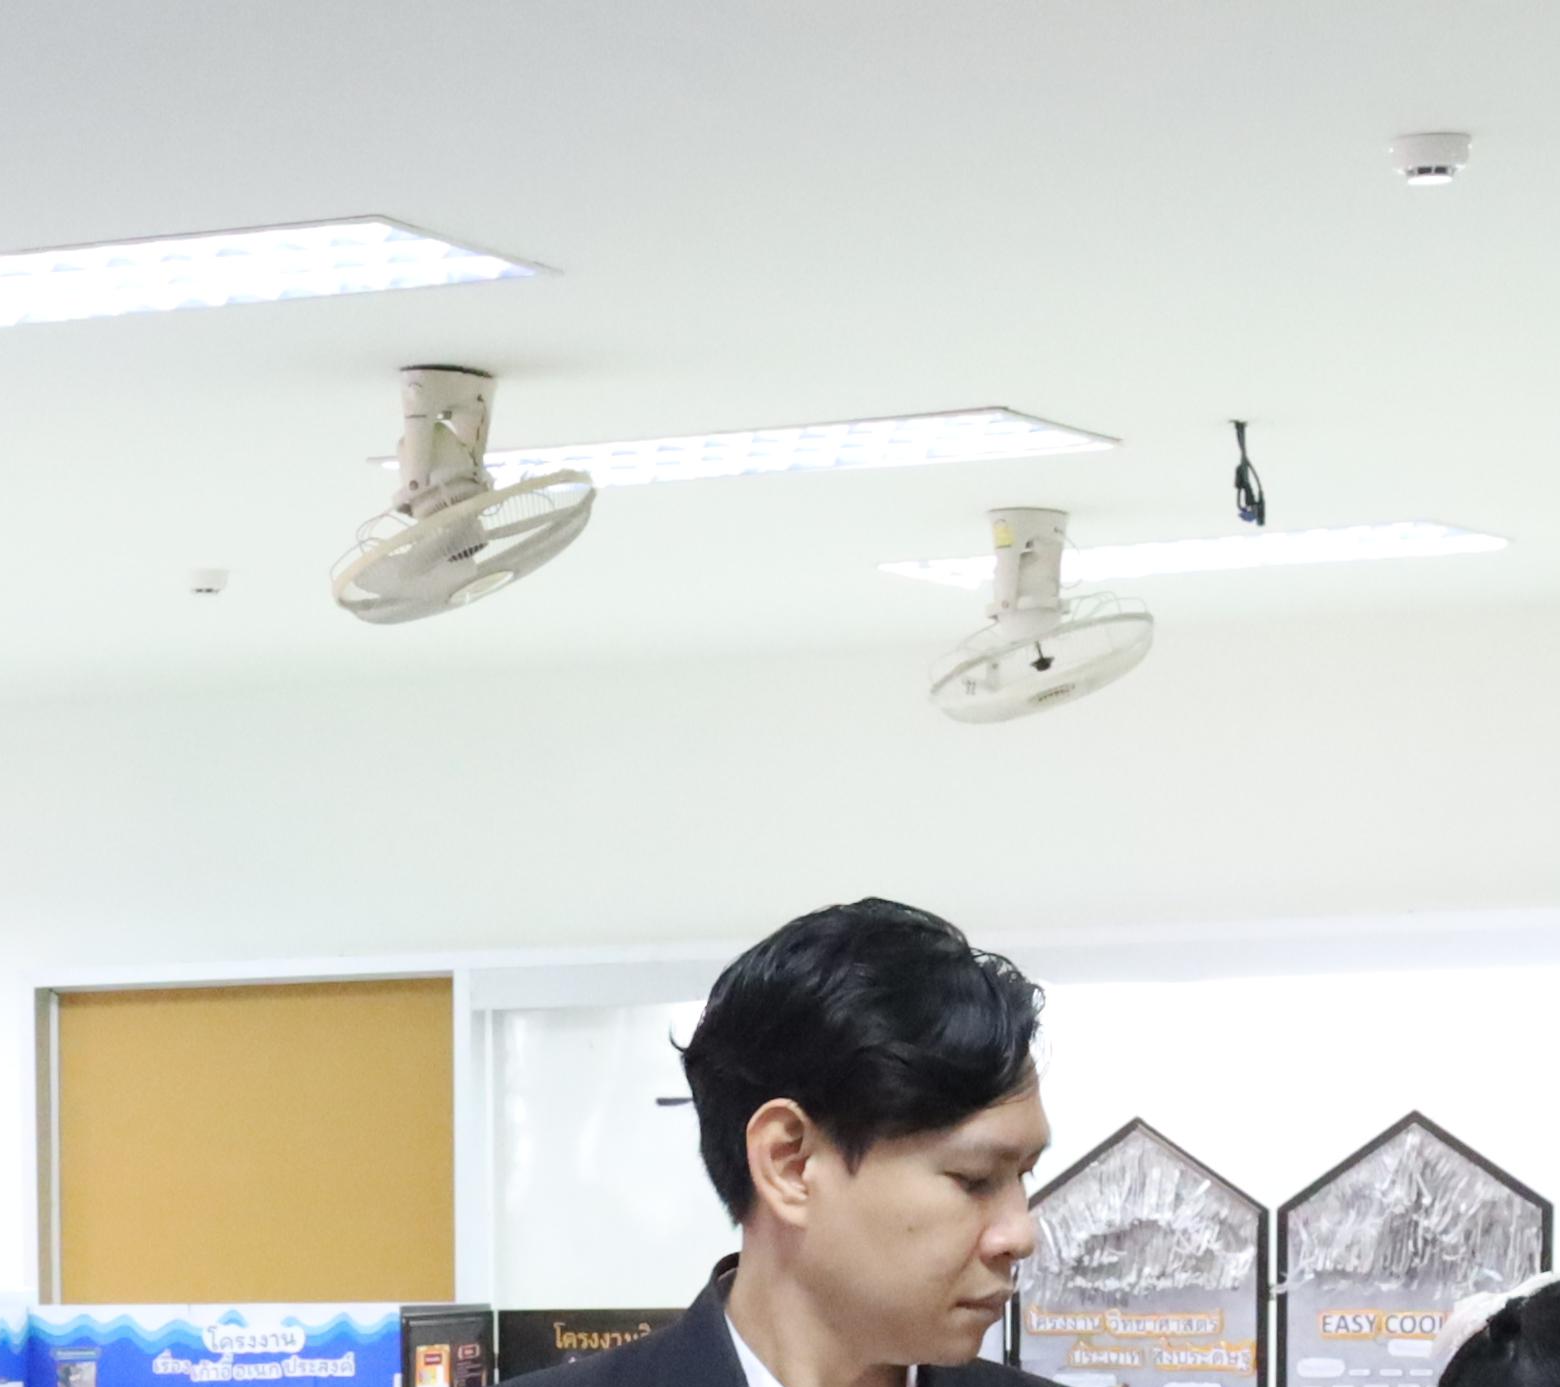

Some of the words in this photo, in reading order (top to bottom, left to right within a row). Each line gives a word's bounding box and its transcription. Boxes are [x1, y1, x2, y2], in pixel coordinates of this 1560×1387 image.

[1321, 1314, 1377, 1334] EASY
[205, 1324, 297, 1351] โครงงาน
